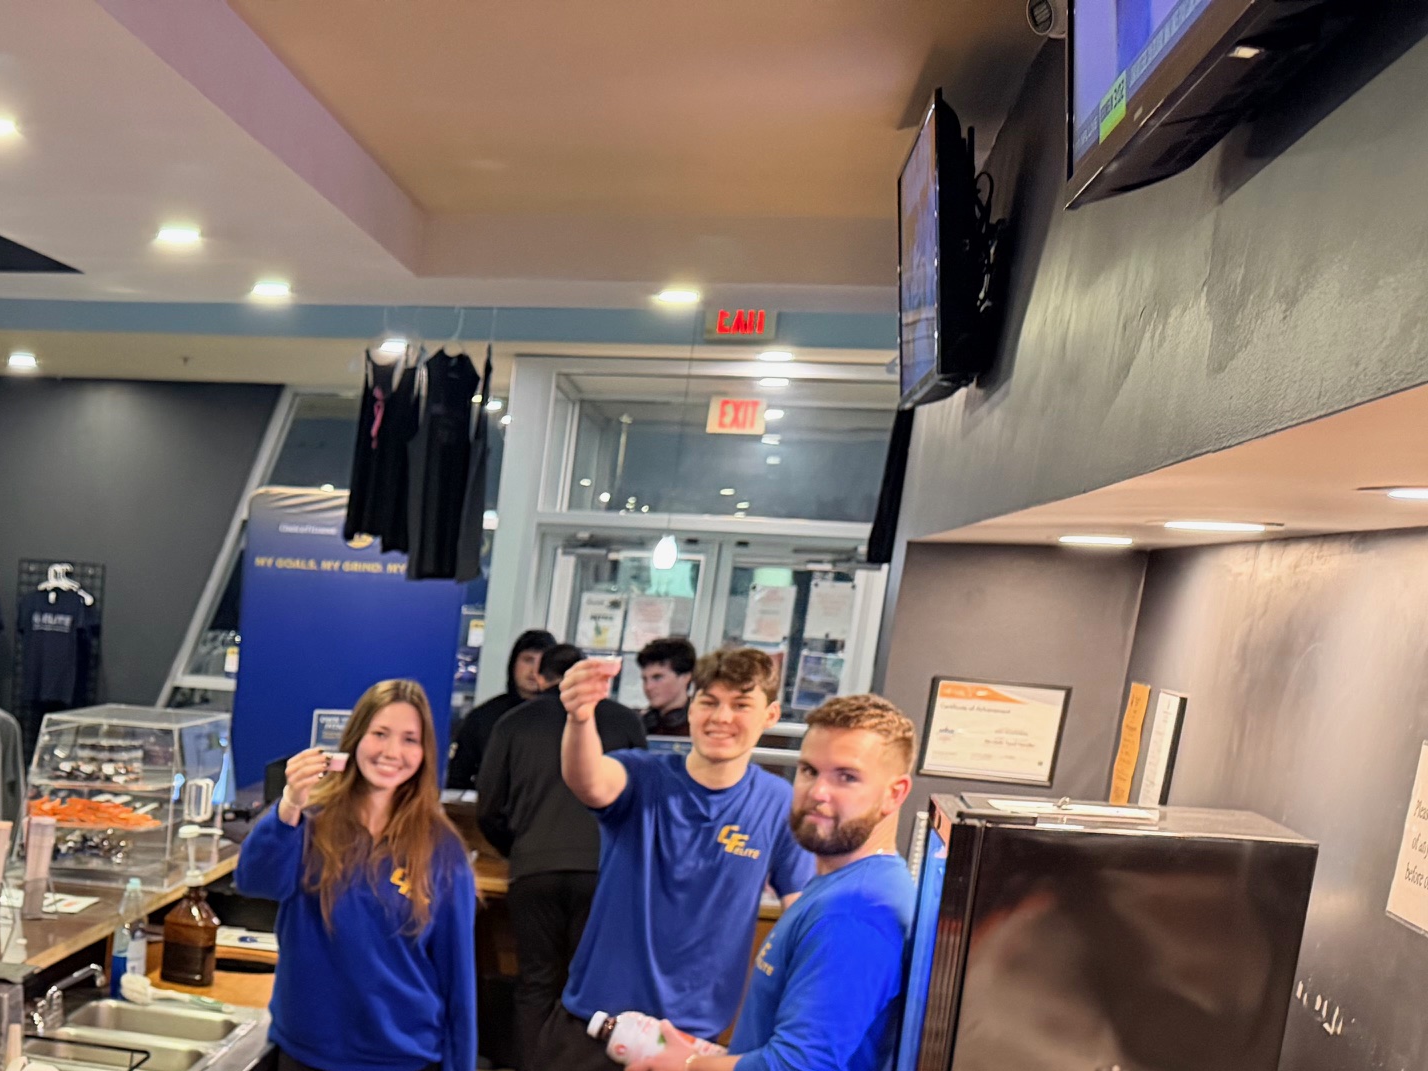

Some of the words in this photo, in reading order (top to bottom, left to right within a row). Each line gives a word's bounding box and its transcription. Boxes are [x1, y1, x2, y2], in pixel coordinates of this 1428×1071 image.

[718, 399, 761, 430] EXIT
[254, 556, 274, 568] MY
[320, 559, 341, 572] MY
